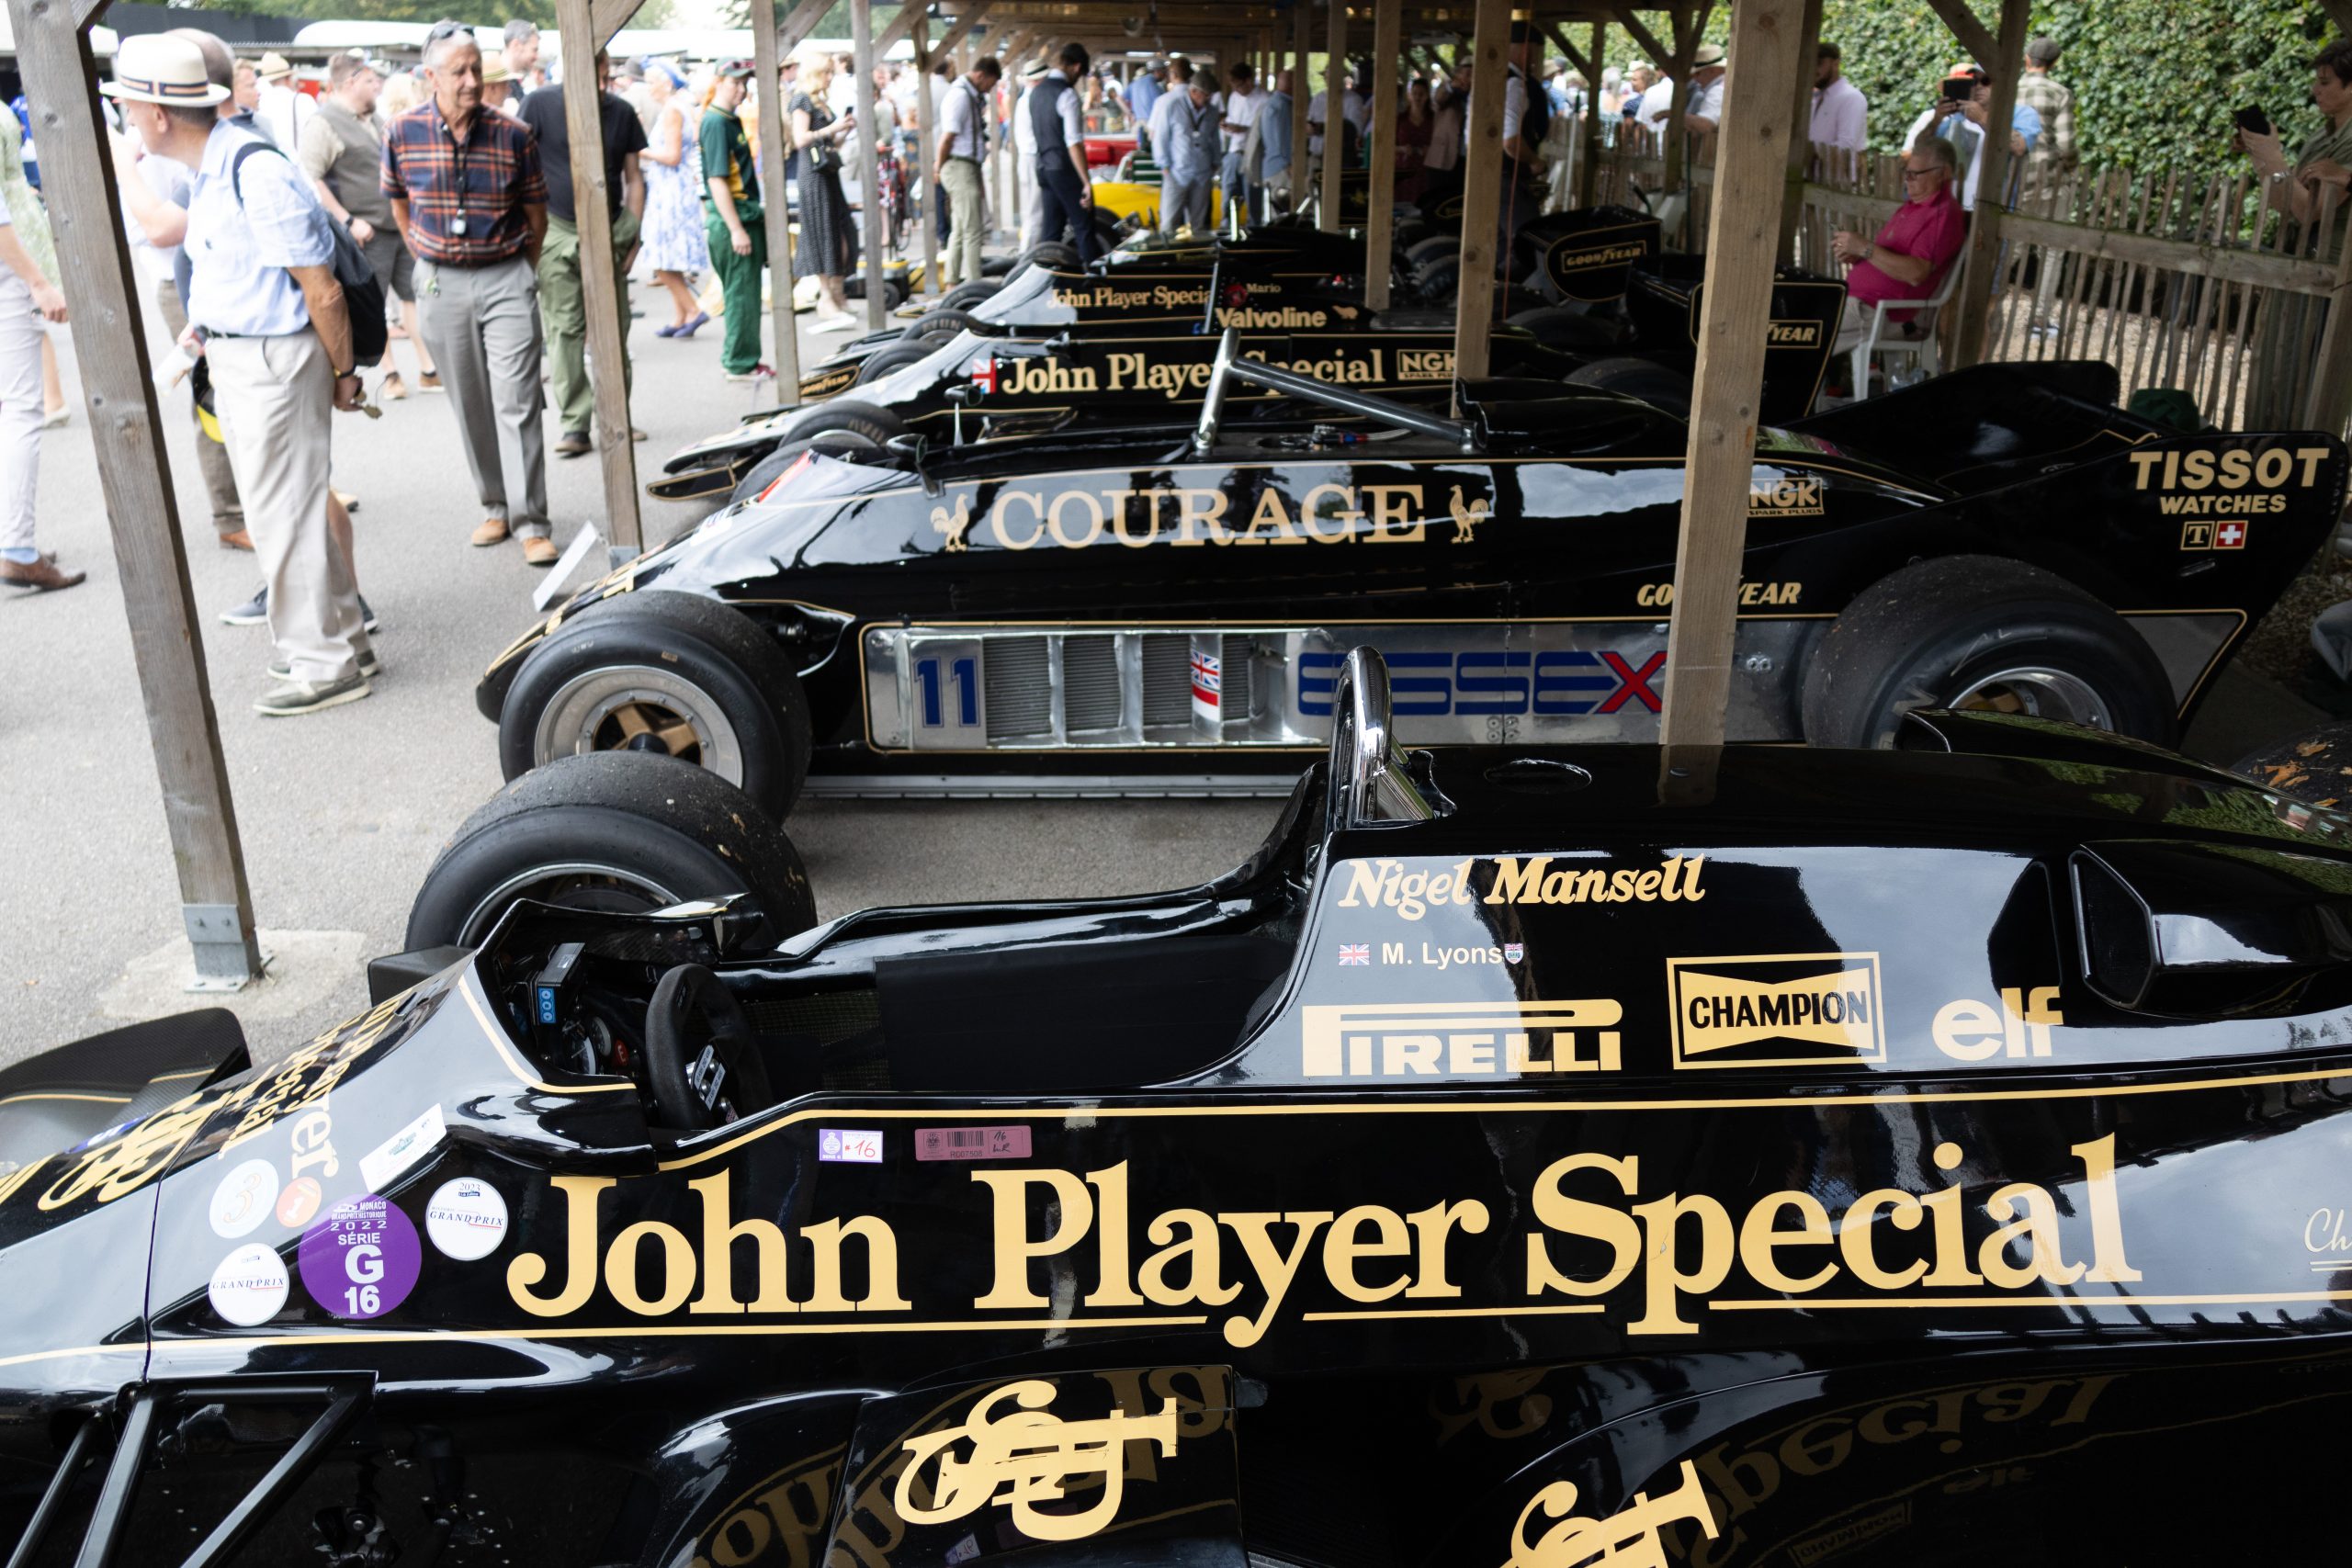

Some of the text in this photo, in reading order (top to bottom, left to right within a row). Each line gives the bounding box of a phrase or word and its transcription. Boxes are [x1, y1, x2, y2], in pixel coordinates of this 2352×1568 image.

[1046, 285, 1211, 310] John Player Specia
[1246, 282, 1282, 294] Mario
[1215, 307, 1327, 328] Valvoline
[1769, 323, 1815, 342] YEAR
[1001, 355, 1099, 395] John
[1105, 353, 1212, 399] Playe
[2130, 447, 2330, 490] TISSOT
[1749, 480, 1817, 508] NGK
[2160, 493, 2287, 514] WATCHES
[990, 484, 1426, 550] COURAGE
[2187, 525, 2210, 544] T
[1636, 582, 1802, 606] GOEAR
[914, 656, 980, 728] 11
[1338, 852, 1706, 920] Nigel Mansell
[1382, 942, 1412, 964] M.
[1423, 942, 1504, 970] Lyons
[1689, 990, 1868, 1029] CHAMPION
[1932, 986, 2064, 1061] elf
[1302, 998, 1623, 1077] PIRELLI
[359, 1201, 387, 1211] MONACO
[430, 1211, 503, 1225] GRAND PRIX
[331, 1220, 387, 1231] 2022
[338, 1232, 380, 1246] SÉRIE
[507, 1132, 2143, 1348] John Player Special
[345, 1244, 384, 1283] G
[212, 1278, 284, 1289] GRAND PRIX
[345, 1284, 380, 1314] 16
